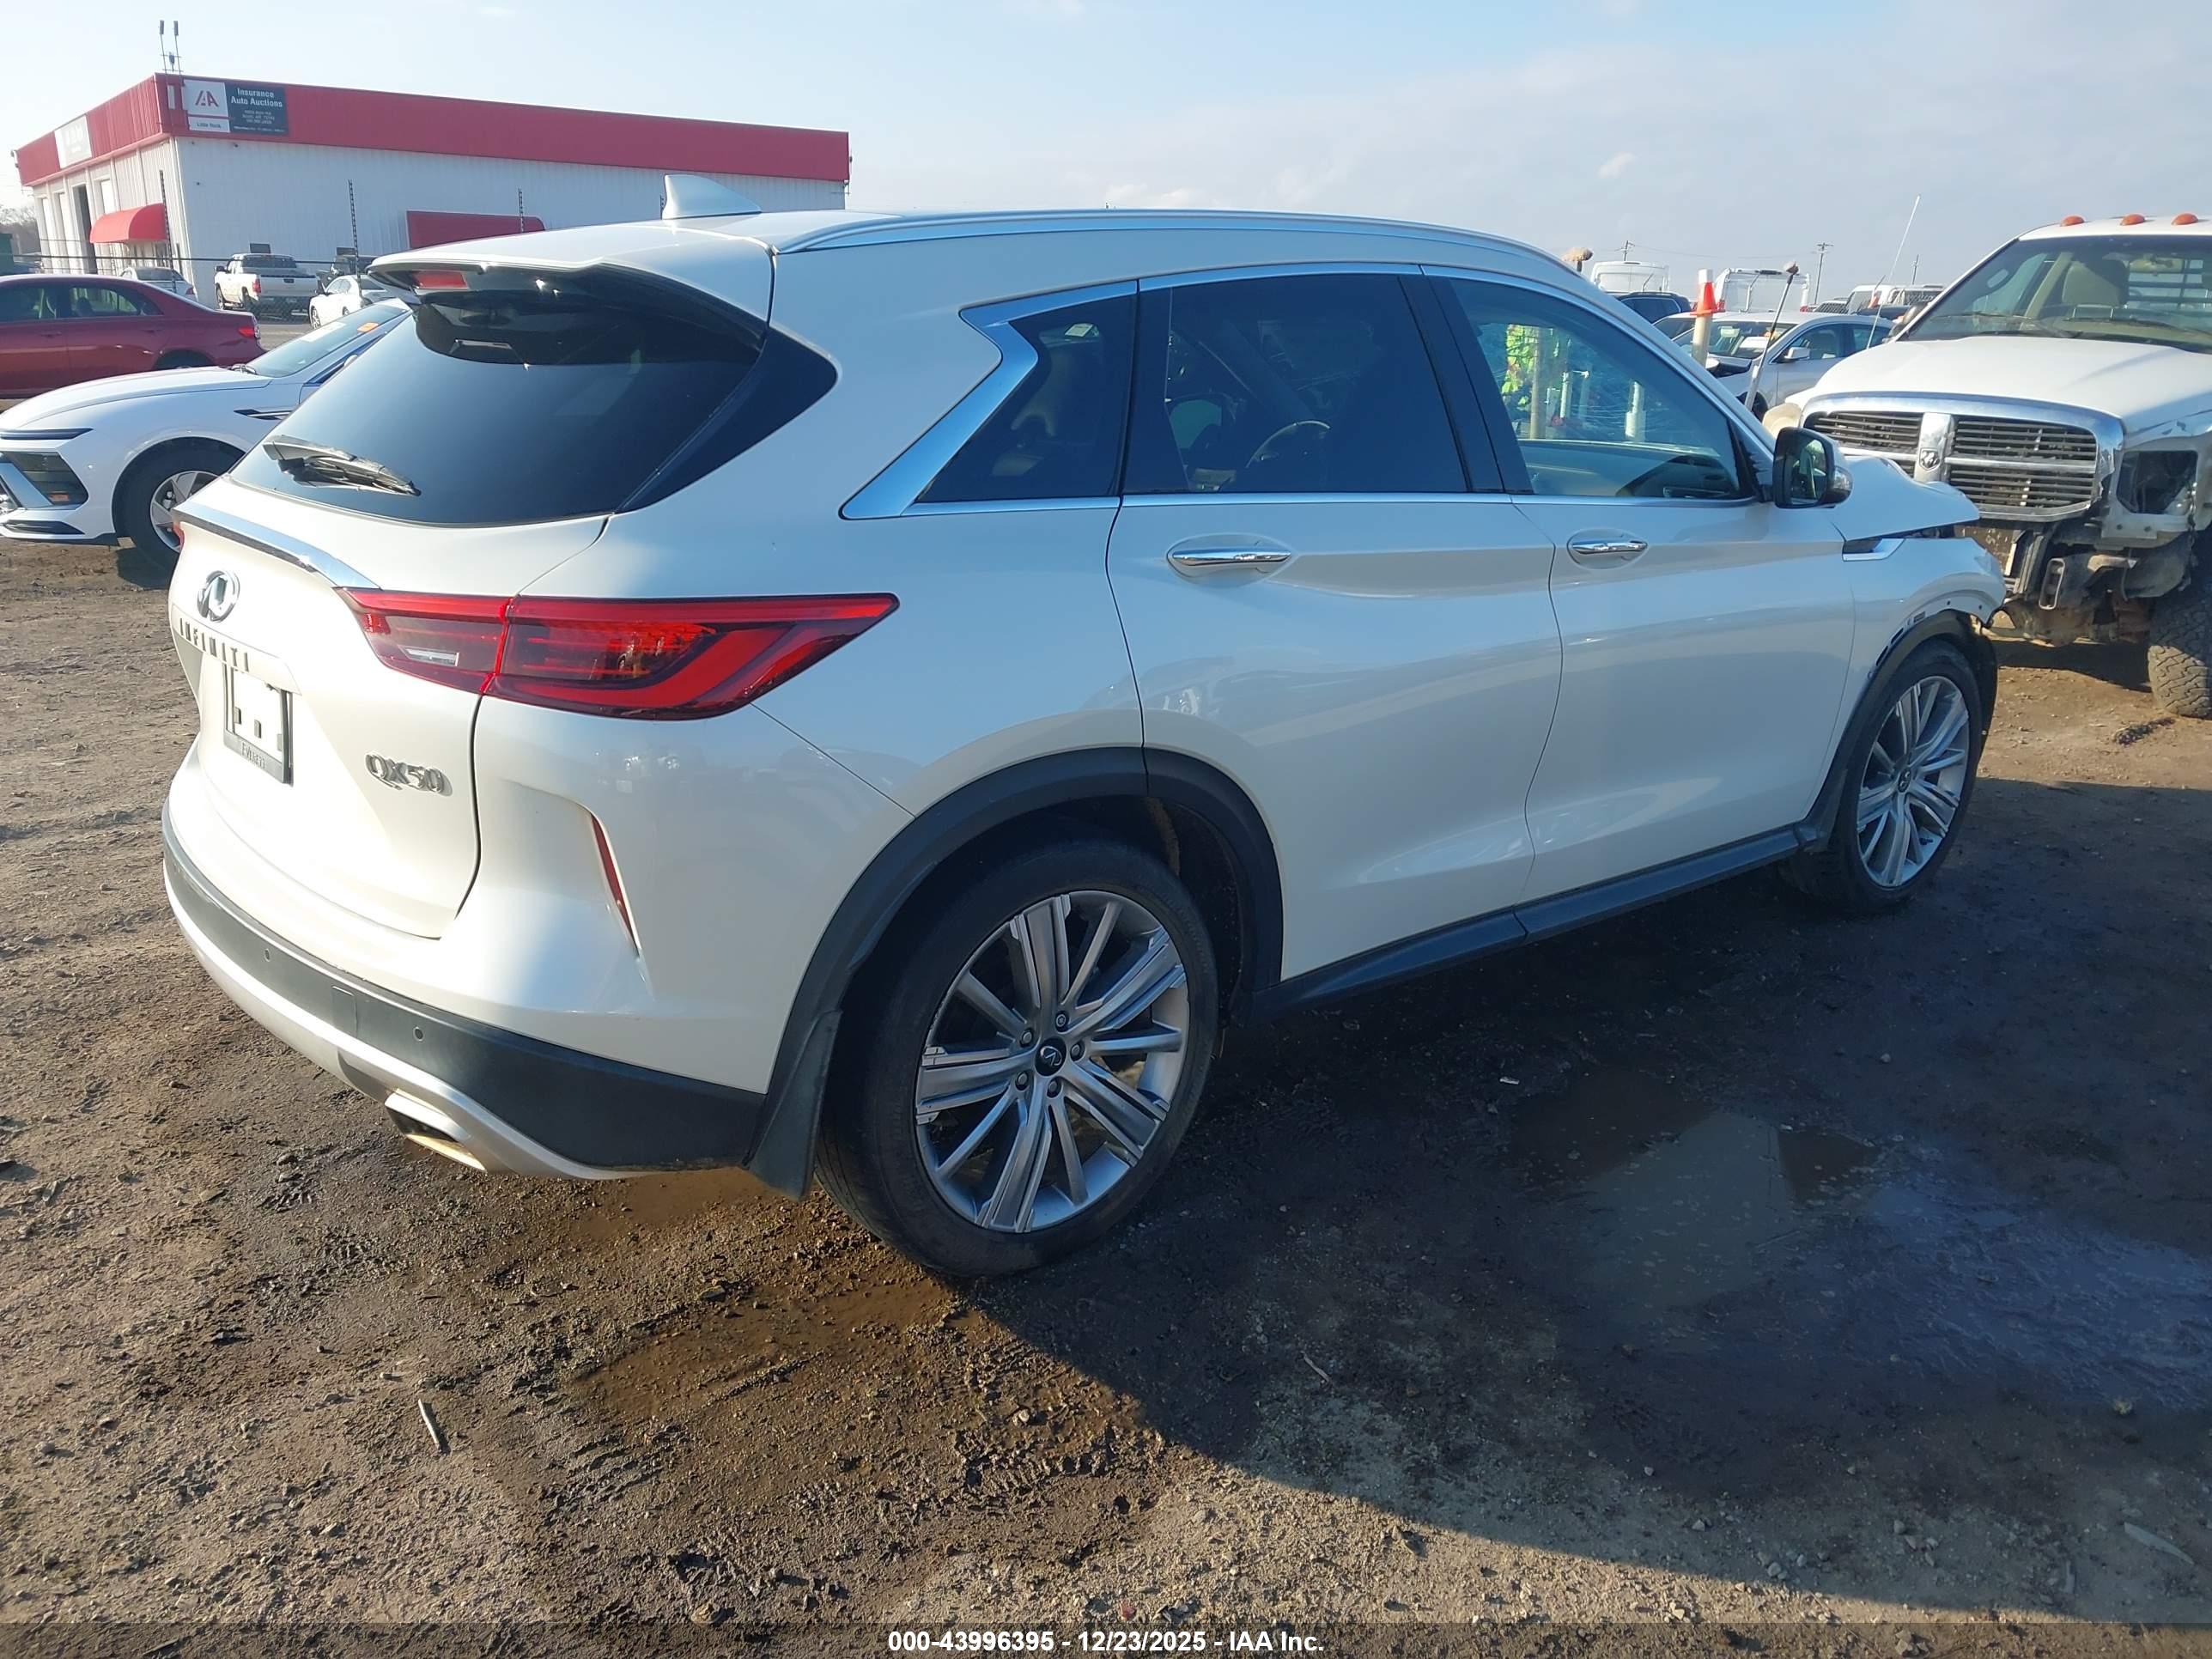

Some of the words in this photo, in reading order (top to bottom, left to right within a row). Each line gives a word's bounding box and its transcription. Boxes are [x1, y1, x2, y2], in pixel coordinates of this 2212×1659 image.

[231, 95, 248, 105] Auto
[250, 97, 283, 107] Auctions
[237, 88, 275, 98] Insurance
[179, 617, 249, 672] INFINITI
[365, 755, 447, 793] QX50
